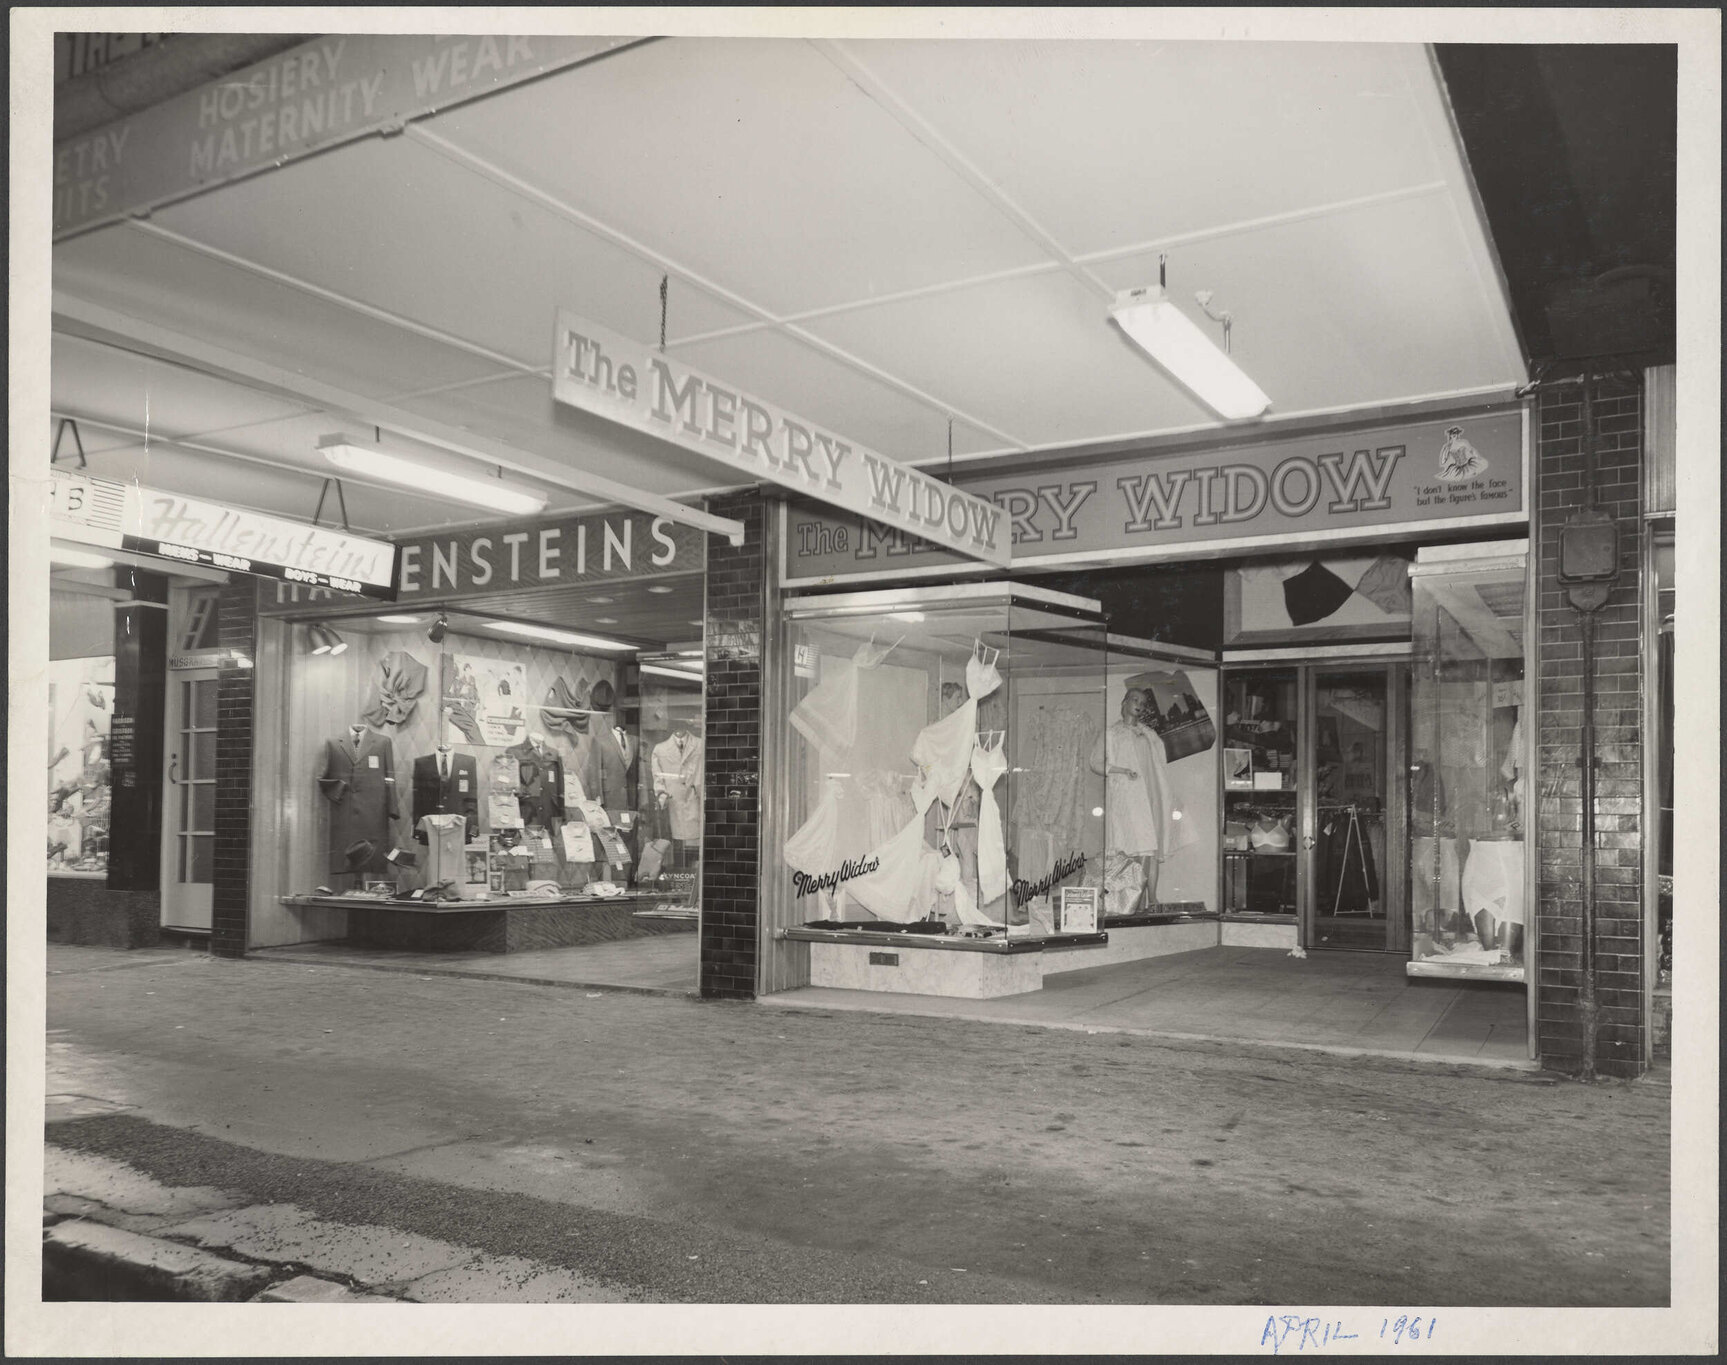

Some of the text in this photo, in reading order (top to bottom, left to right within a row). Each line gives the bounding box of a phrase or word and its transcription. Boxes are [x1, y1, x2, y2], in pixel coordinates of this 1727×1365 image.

[201, 39, 347, 129] HOSIERY
[411, 35, 535, 98] WEAR
[188, 72, 384, 178] MATERNITY
[564, 330, 1001, 551] The MERRY WIDOW
[798, 521, 850, 559] The
[1117, 445, 1406, 534] WIDOW
[1416, 496, 1430, 506] but
[1434, 495, 1446, 504] the
[1448, 483, 1467, 493] know
[1471, 480, 1485, 490] the
[1489, 478, 1507, 488] face
[151, 498, 378, 581] Hallensteins
[793, 854, 880, 899] Merry Widow
[1013, 850, 1087, 909] Merry Widow
[1261, 1315, 1437, 1355] APRIL 1961
